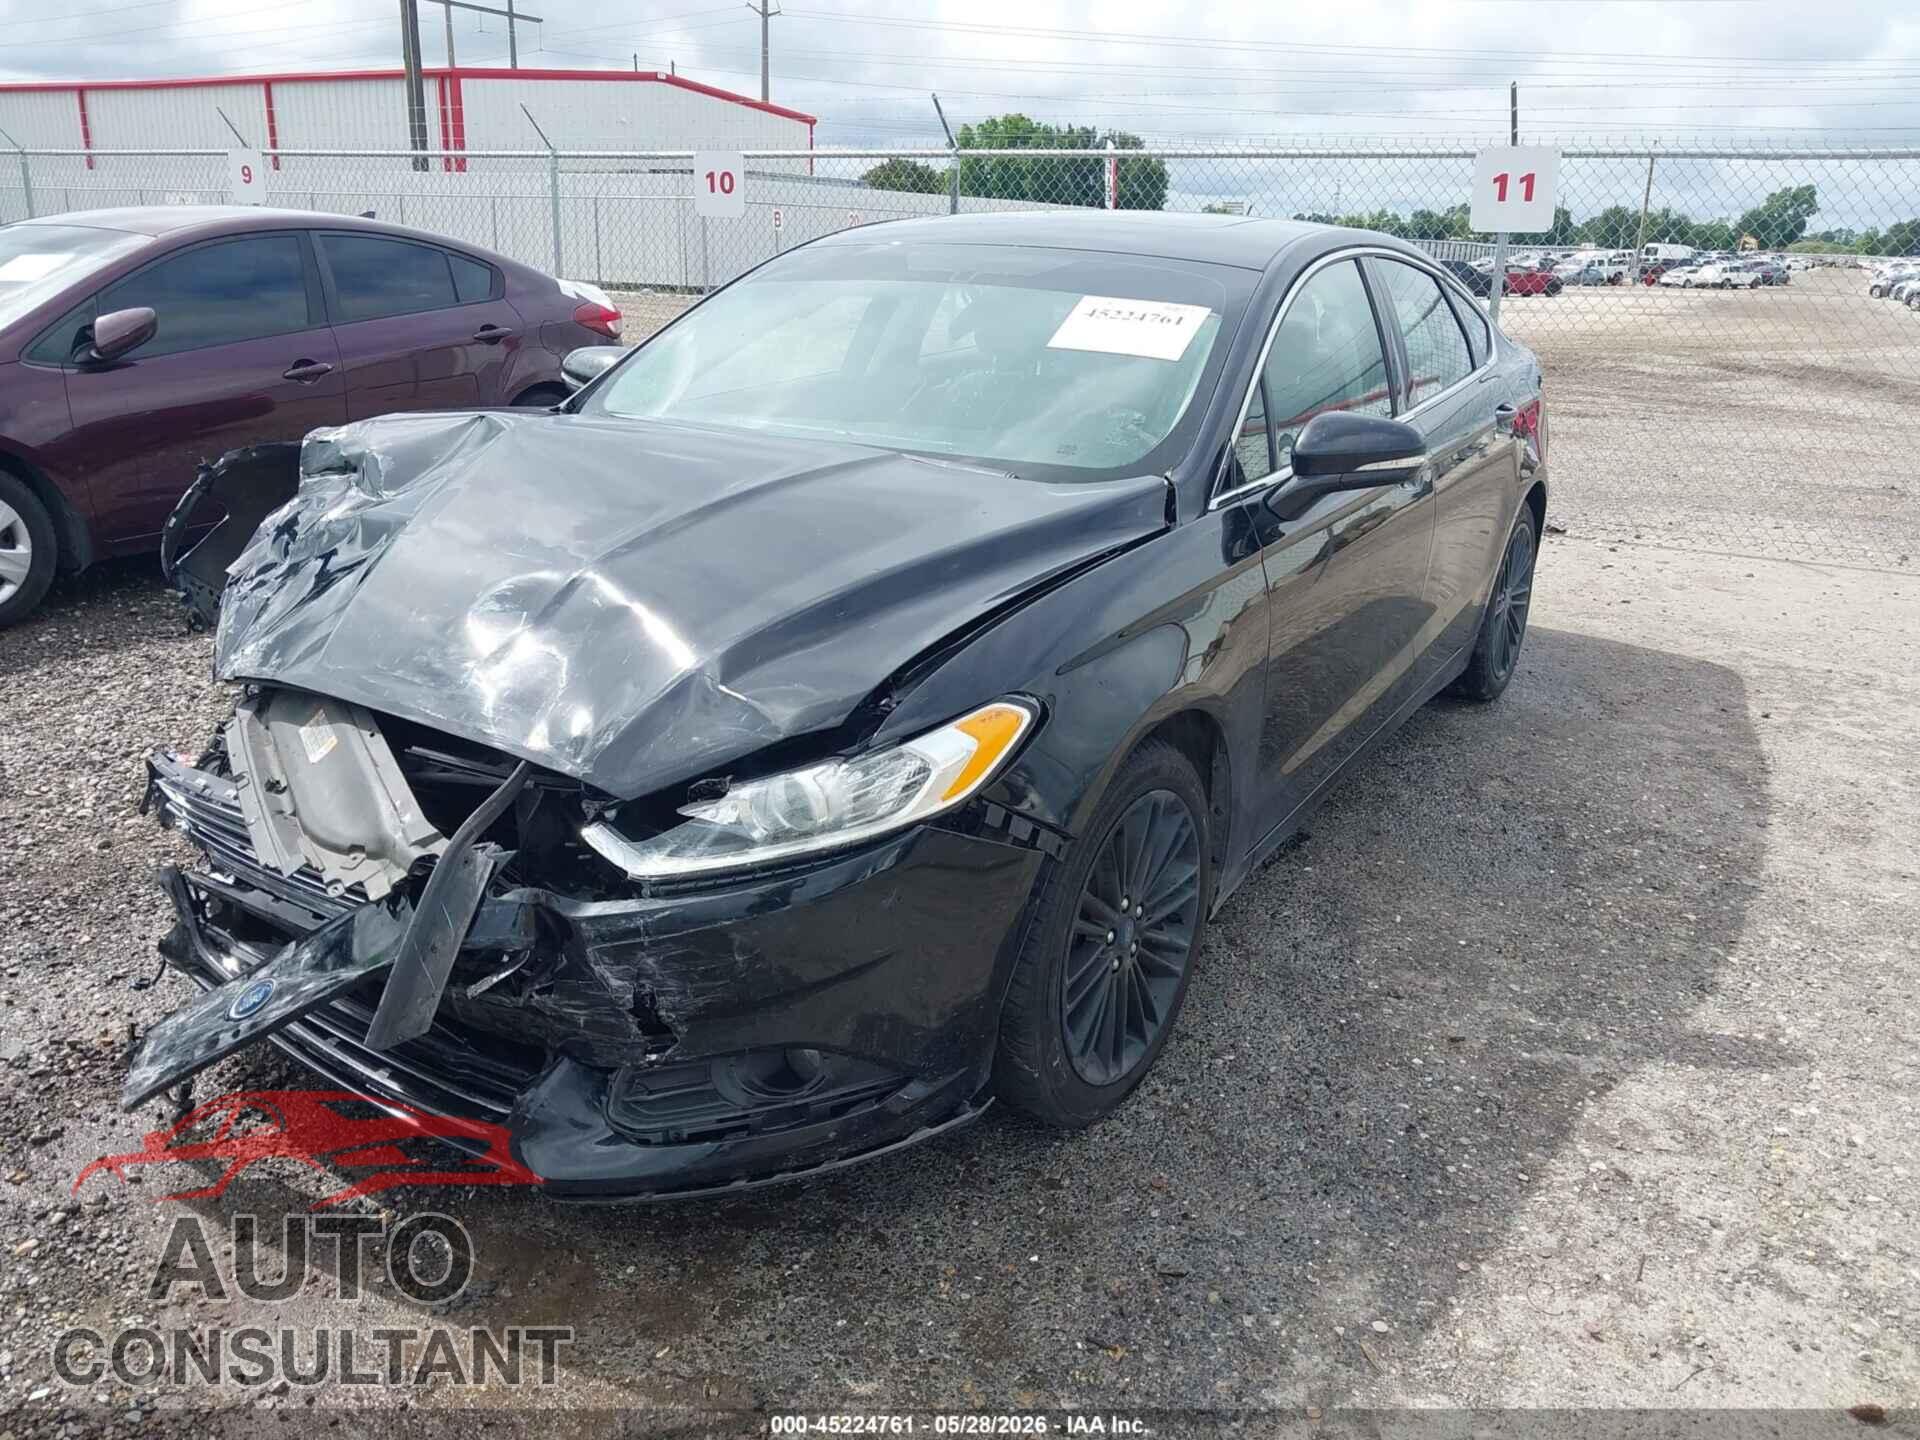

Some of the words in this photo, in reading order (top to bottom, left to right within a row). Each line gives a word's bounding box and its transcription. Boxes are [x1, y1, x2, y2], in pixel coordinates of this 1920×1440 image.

[241, 165, 252, 185] 9
[706, 171, 735, 194] 10
[1493, 173, 1536, 202] 11
[1085, 309, 1185, 325] 45224761
